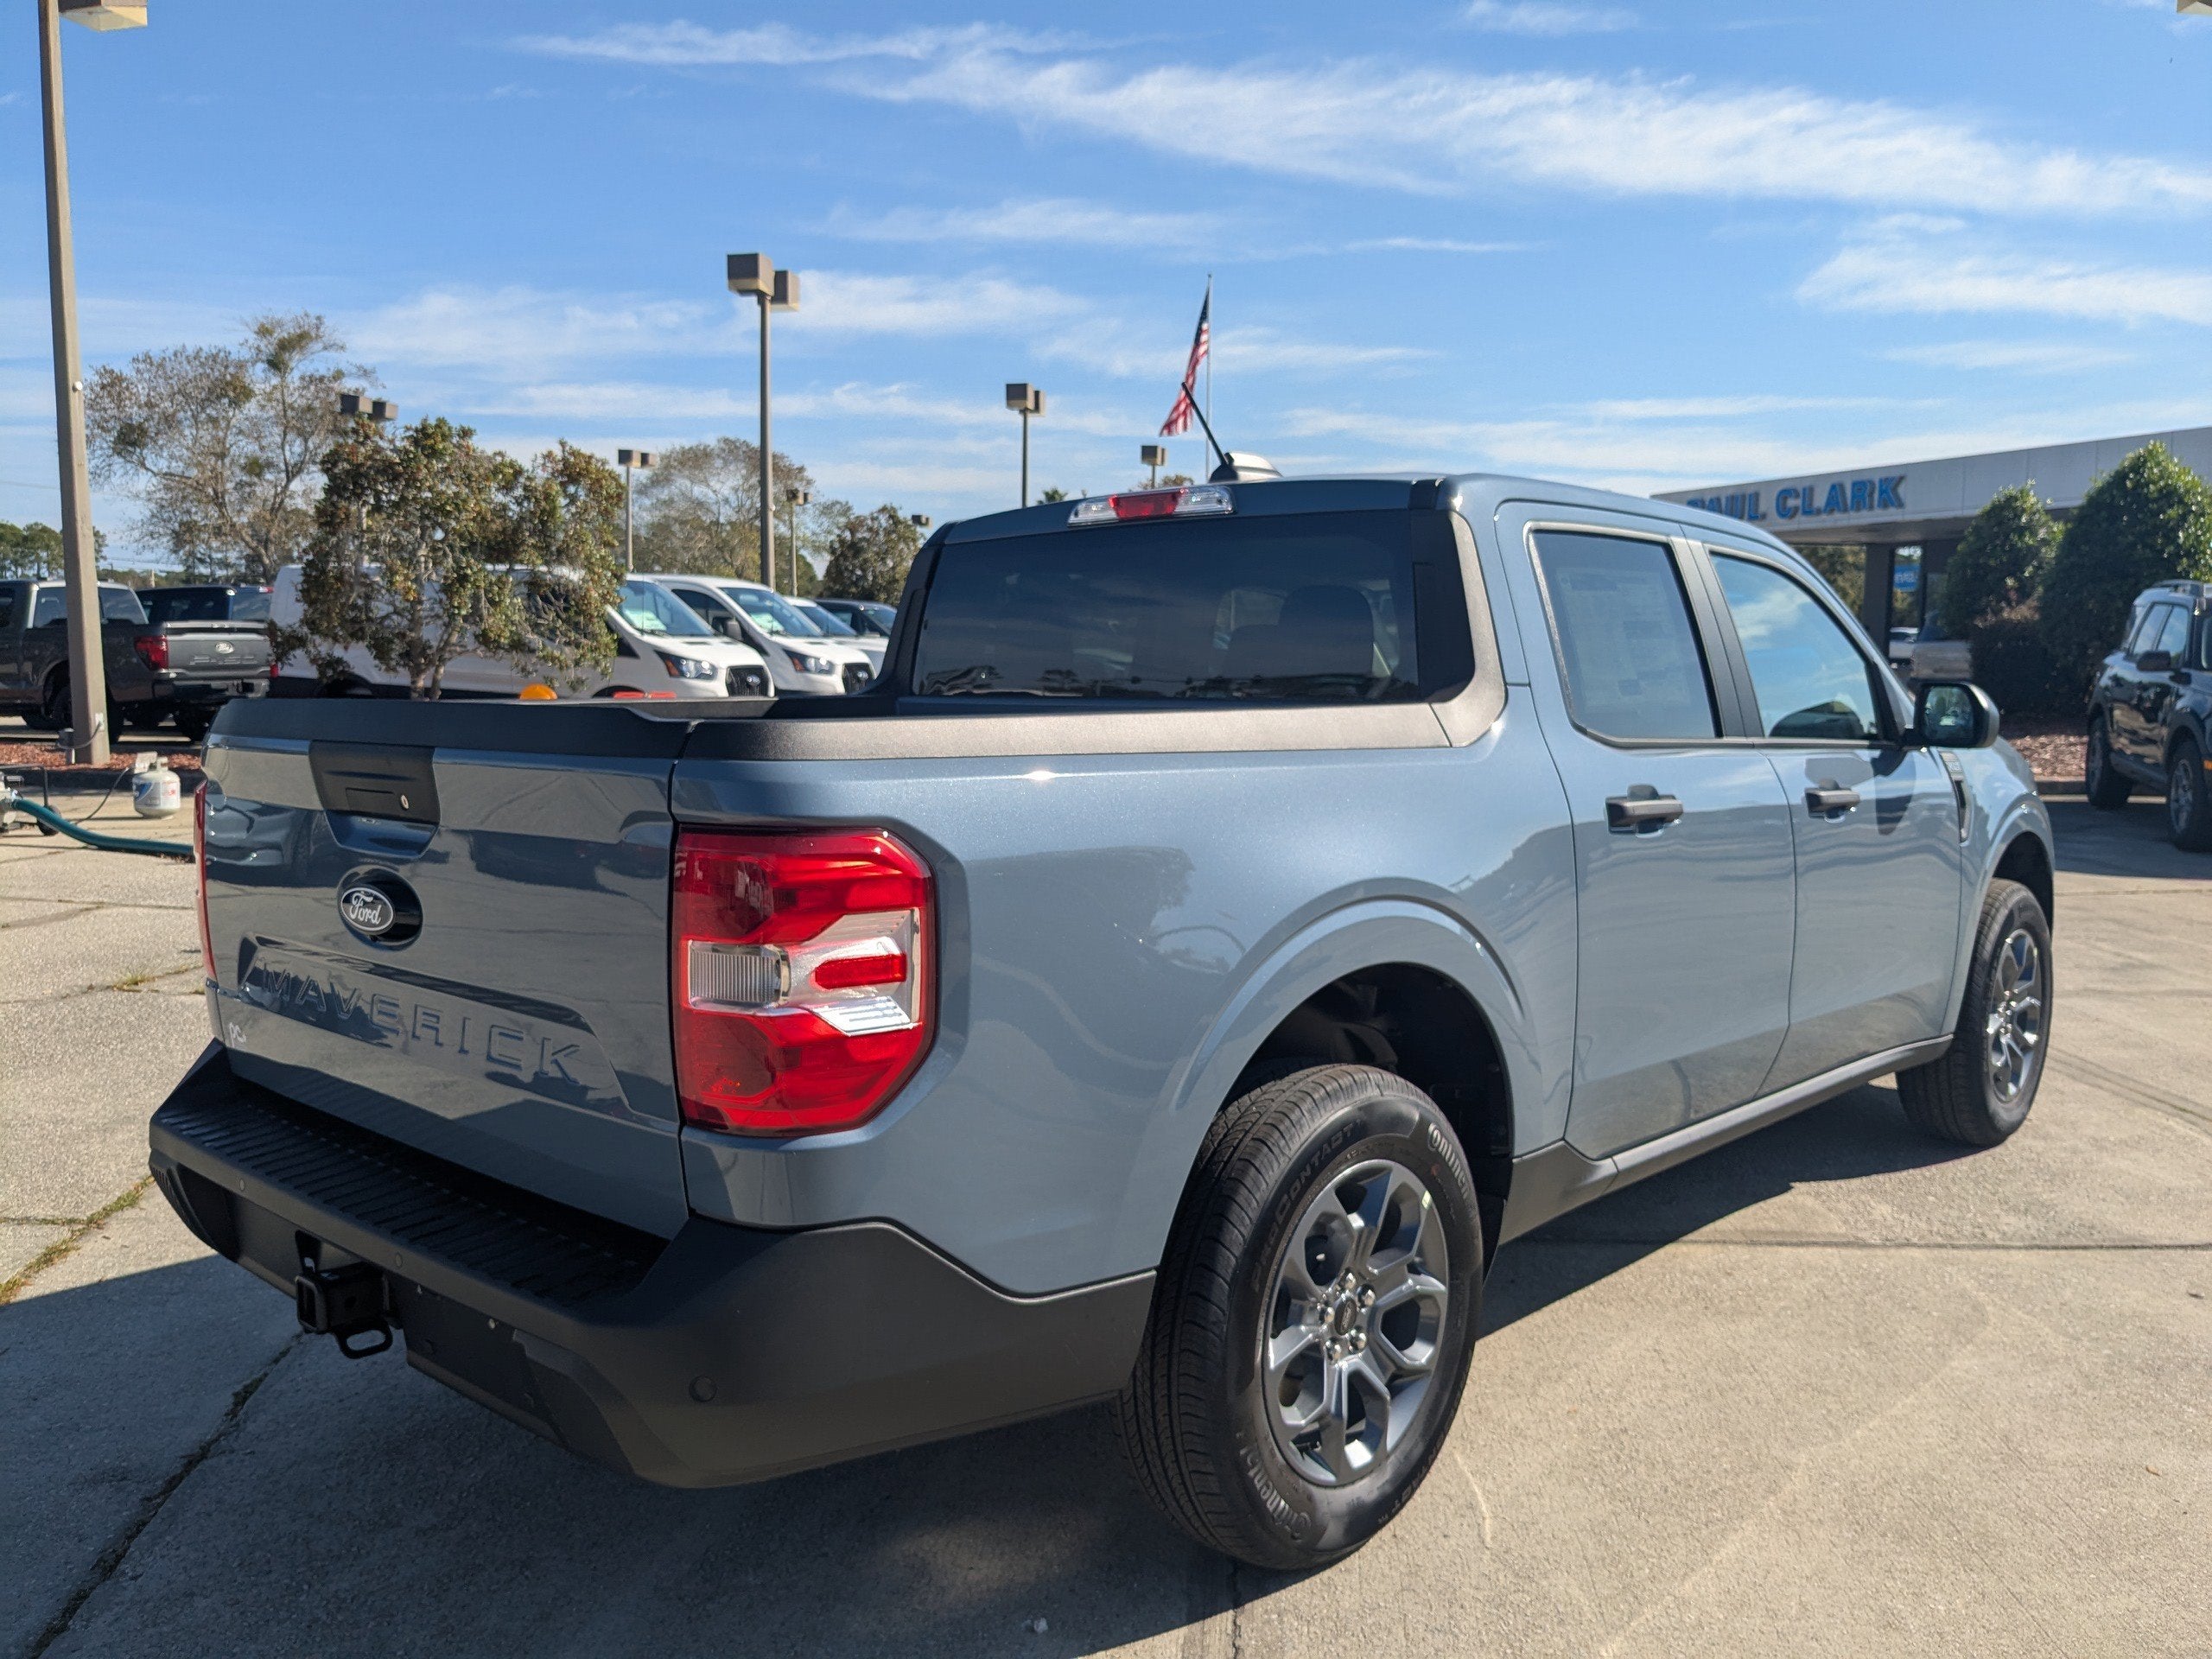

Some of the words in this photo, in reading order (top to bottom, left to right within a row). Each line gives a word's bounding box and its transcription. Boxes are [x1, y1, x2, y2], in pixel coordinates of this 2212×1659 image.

[1776, 476, 1903, 519] CLARK
[349, 891, 382, 925] Ford
[262, 962, 581, 1085] MAVERICK
